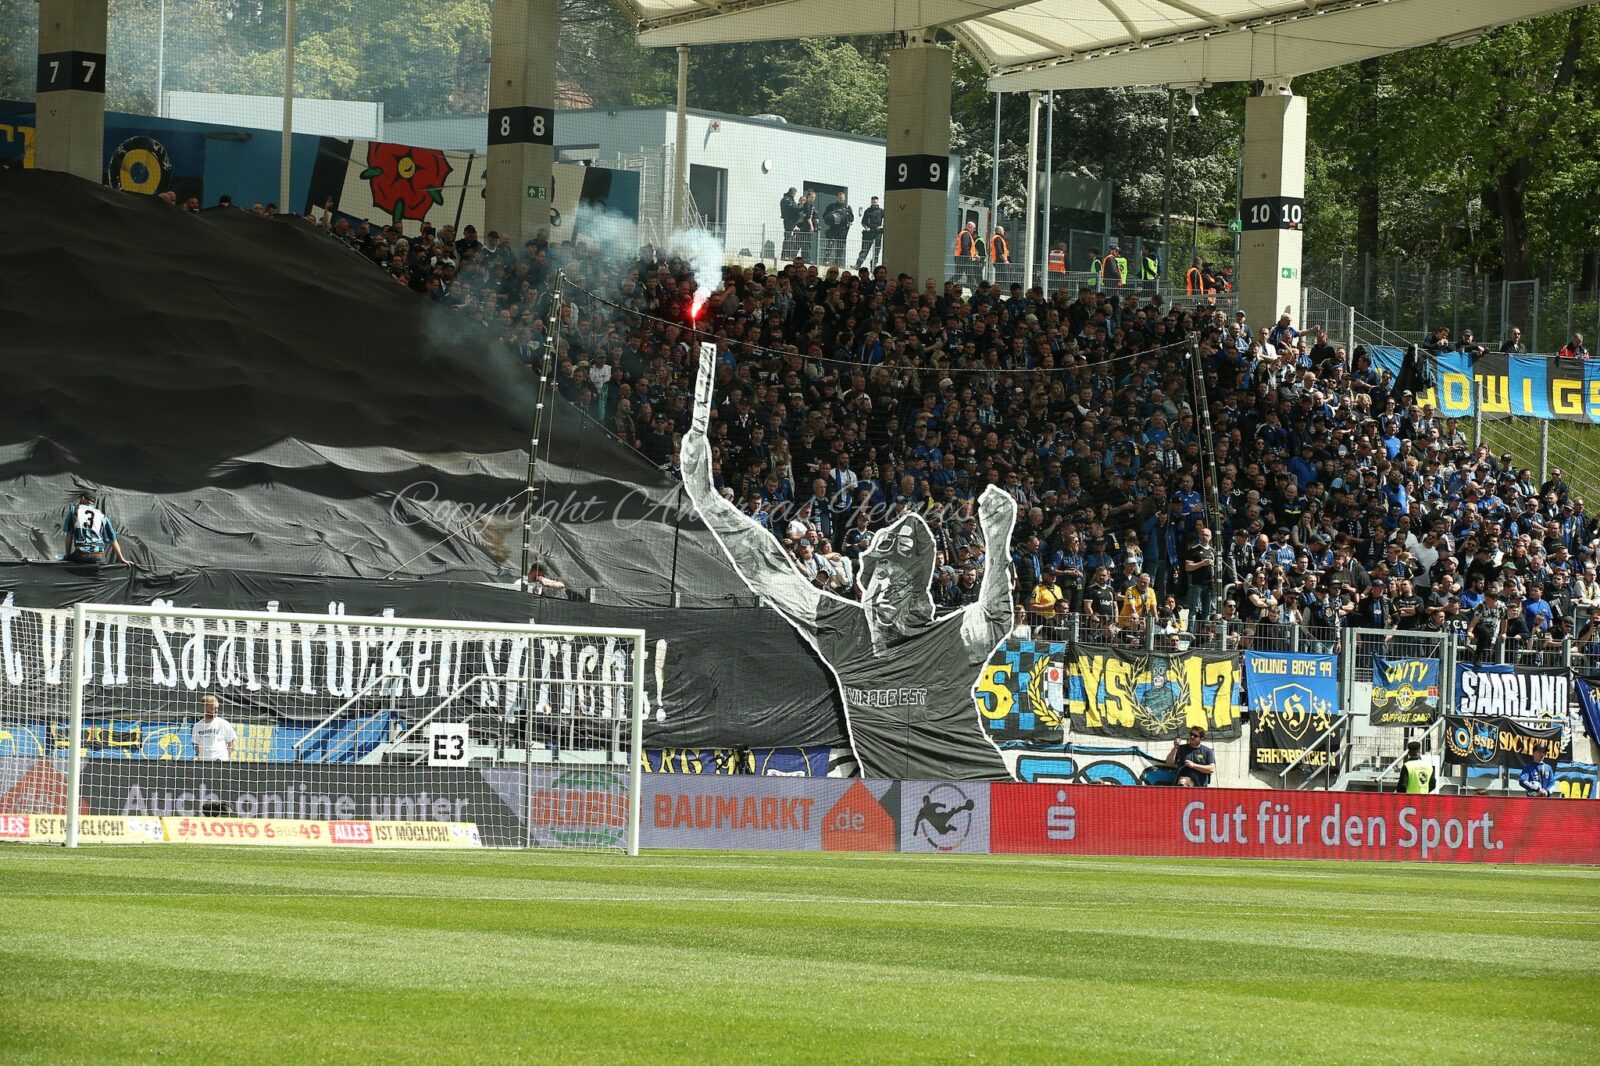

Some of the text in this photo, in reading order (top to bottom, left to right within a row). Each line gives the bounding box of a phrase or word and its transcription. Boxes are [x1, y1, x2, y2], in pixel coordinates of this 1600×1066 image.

[50, 61, 60, 84] 7
[82, 61, 96, 83] 7
[500, 115, 511, 136] 8
[532, 115, 545, 136] 8
[898, 163, 908, 183] 9
[929, 163, 940, 183] 9
[1251, 204, 1270, 223] 10
[1282, 203, 1302, 223] 10
[83, 510, 95, 528] 3
[1251, 658, 1333, 677] YOUNG BOYS 99
[1385, 661, 1428, 683] UNITY
[847, 688, 928, 707] VIRAGE EST
[1077, 656, 1234, 731] YS 17
[1461, 670, 1568, 717] SAARLAND
[1381, 713, 1411, 723] SUPPORT
[433, 735, 465, 760] E3
[122, 783, 470, 822] Auch online unter
[654, 794, 815, 831] BAUMARKT
[35, 818, 57, 835] IST
[59, 819, 124, 836] MGLICH!
[201, 822, 260, 838] LOTTO
[334, 823, 450, 842] ALLES IST MÖGLICH!
[1182, 800, 1504, 859] Gut für den Sport.
